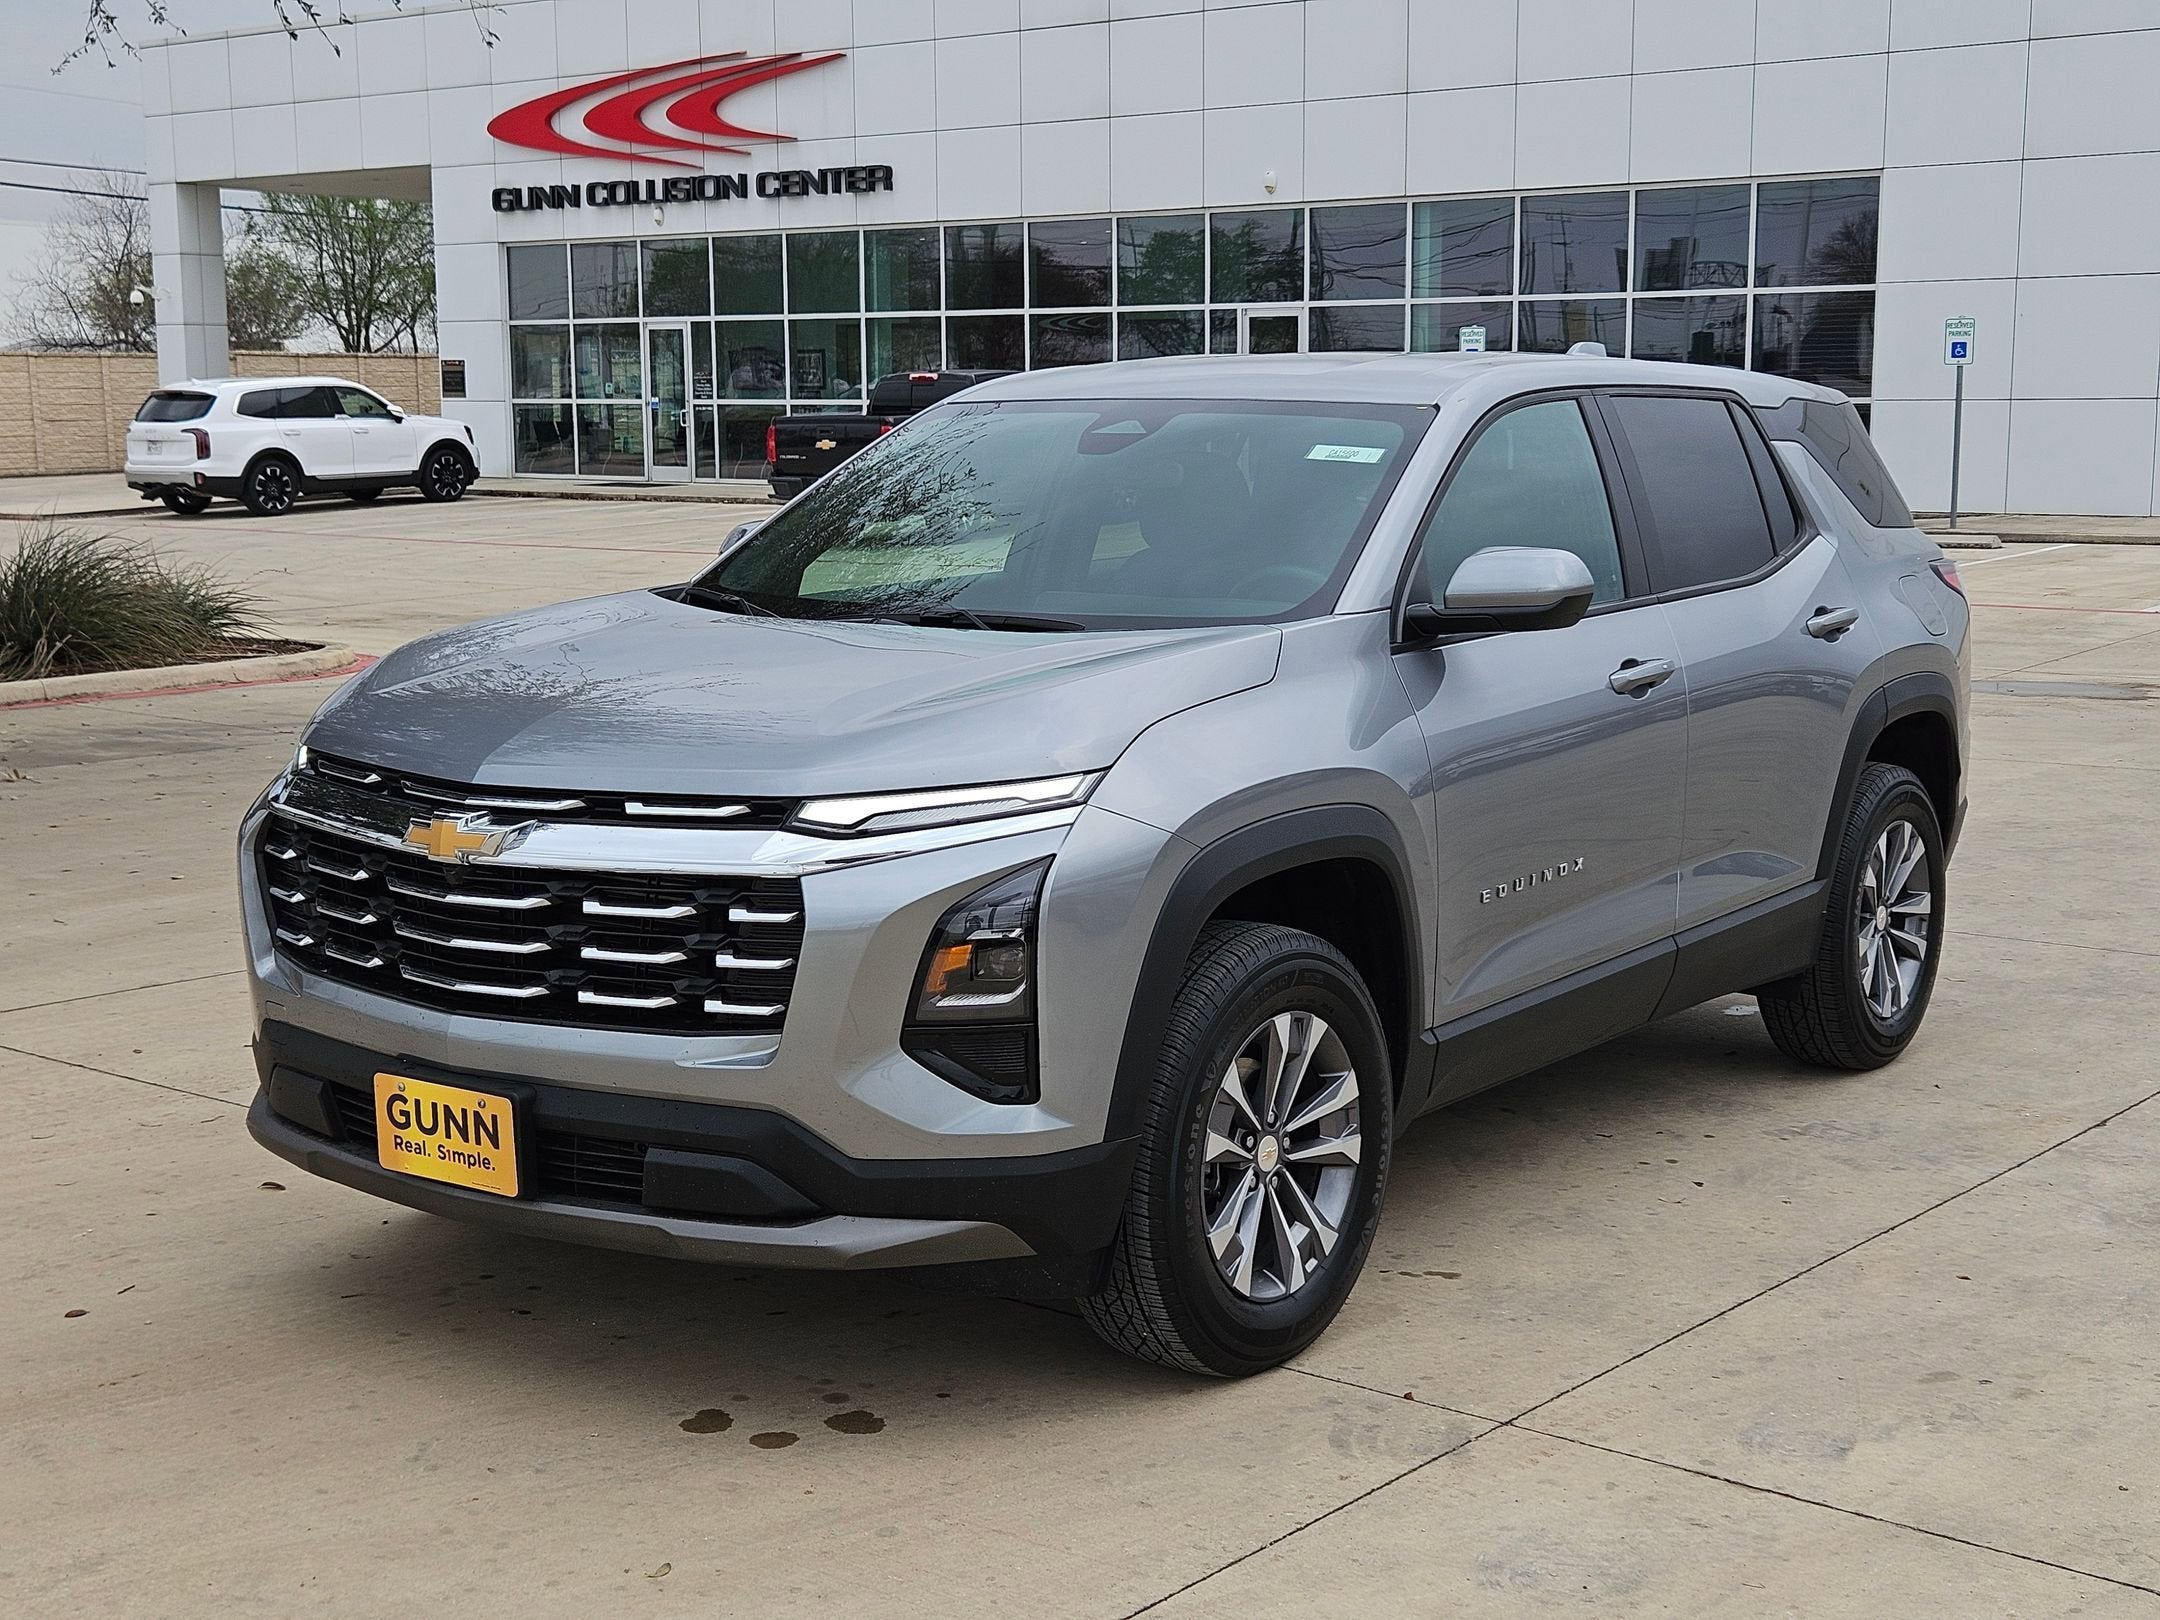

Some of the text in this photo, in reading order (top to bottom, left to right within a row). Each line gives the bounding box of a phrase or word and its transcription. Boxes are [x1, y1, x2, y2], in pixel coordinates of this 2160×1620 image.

[492, 165, 893, 212] GUNN COLLISION CENTER
[1480, 857, 1584, 904] EQUINOX
[386, 1093, 500, 1150] GUNN
[394, 1134, 431, 1158] Real.
